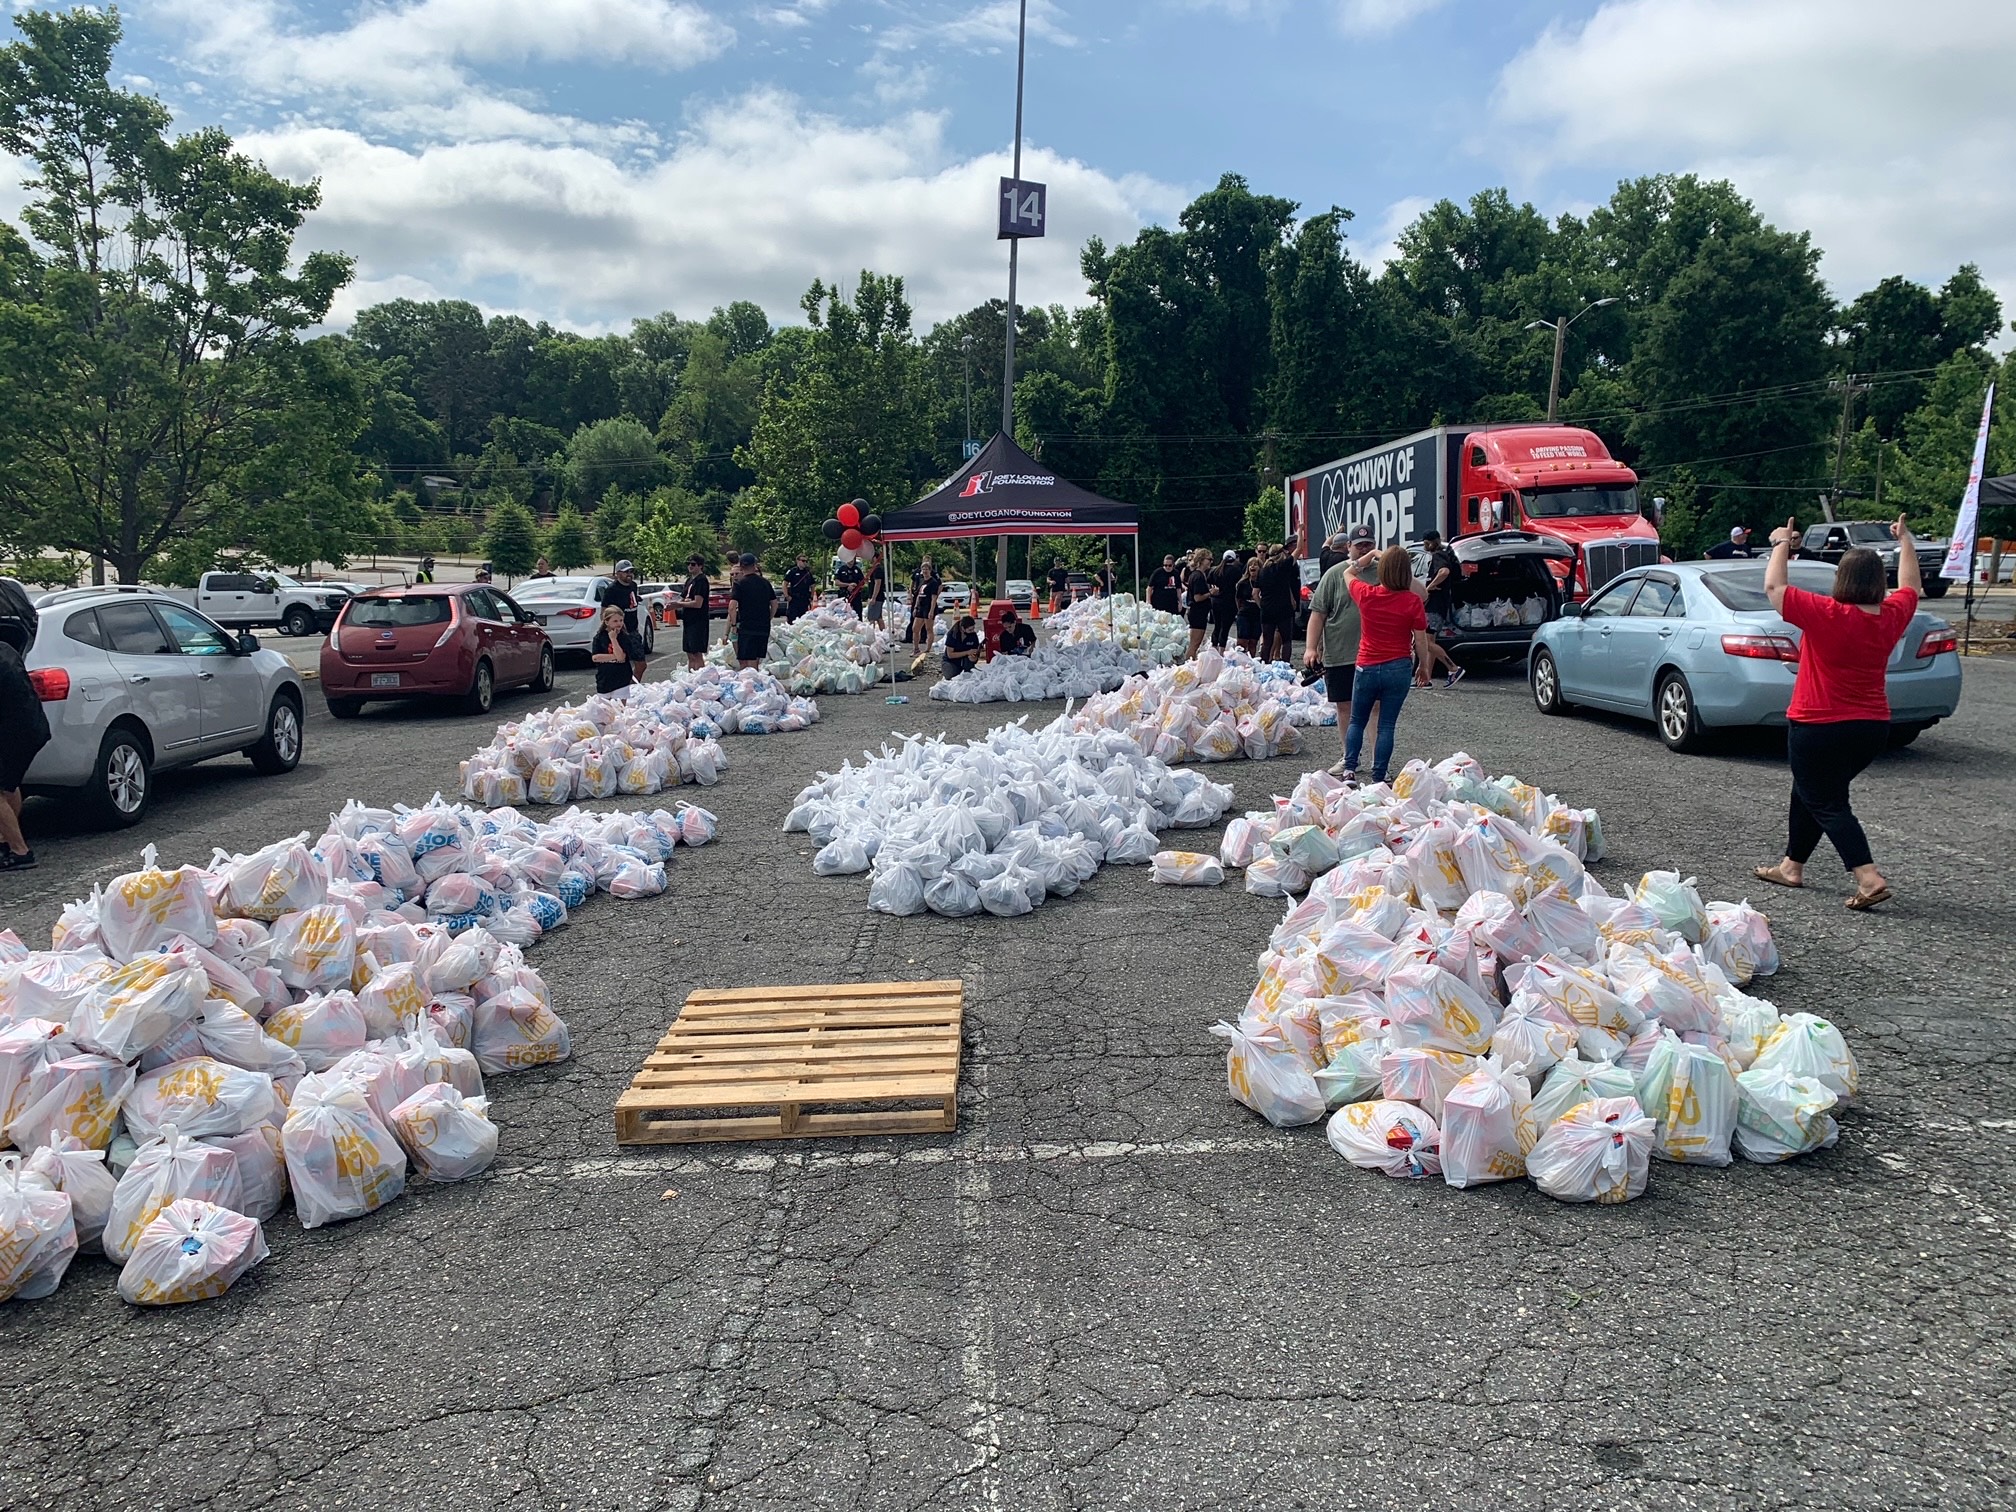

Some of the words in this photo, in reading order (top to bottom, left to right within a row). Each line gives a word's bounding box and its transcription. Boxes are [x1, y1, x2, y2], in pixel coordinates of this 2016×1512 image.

[1003, 187, 1042, 227] 14
[965, 442, 980, 456] 16
[1346, 452, 1395, 496] CONVOY
[1396, 446, 1415, 484] OF
[948, 509, 1072, 522] @JOEYLOGANOFOUNDATION
[243, 904, 281, 914] CONVOY
[544, 1043, 559, 1051] OF
[505, 1050, 558, 1065] HOPE
[1496, 1150, 1525, 1168] CONVO
